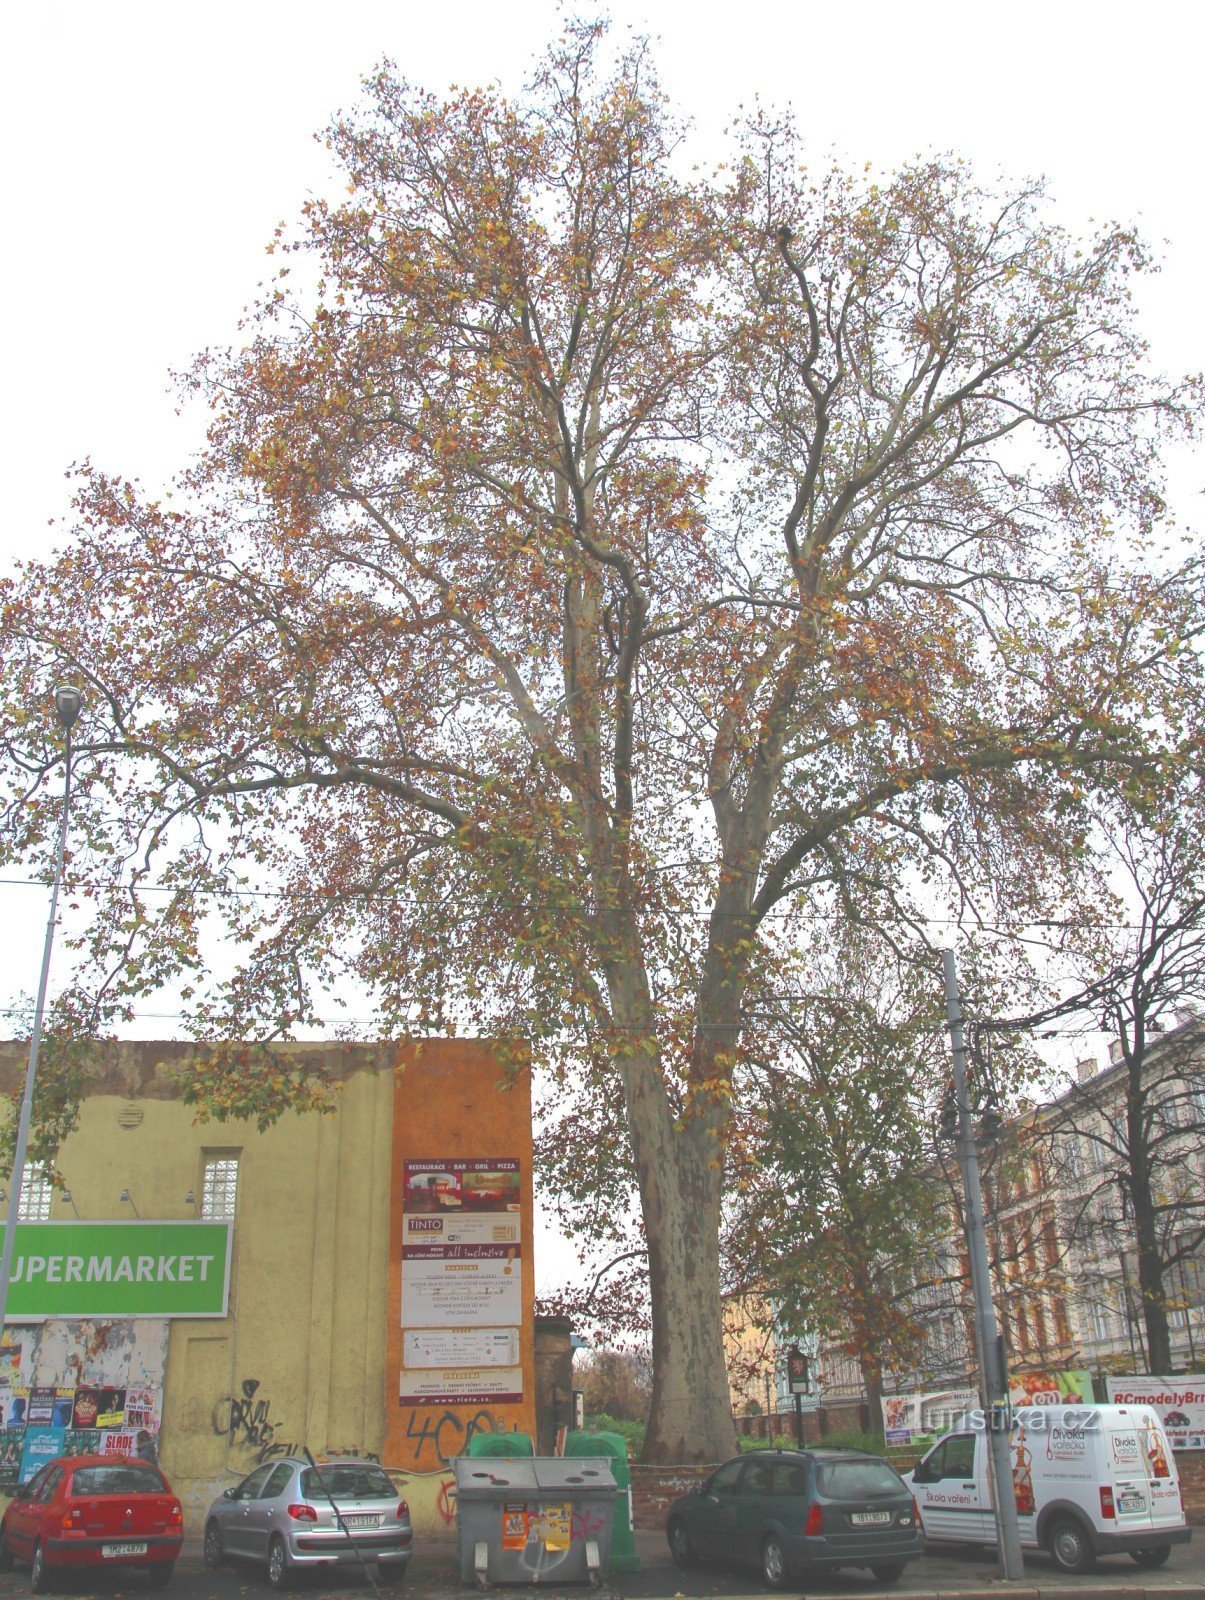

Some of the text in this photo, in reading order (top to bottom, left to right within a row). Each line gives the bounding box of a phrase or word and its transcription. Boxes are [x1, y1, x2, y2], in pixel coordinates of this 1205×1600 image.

[410, 1220, 442, 1230] TINTO
[464, 1246, 504, 1258] inclusive
[0, 1255, 215, 1284] UPERMARKET
[105, 1435, 133, 1449] SLADE
[926, 1490, 946, 1502] Škola
